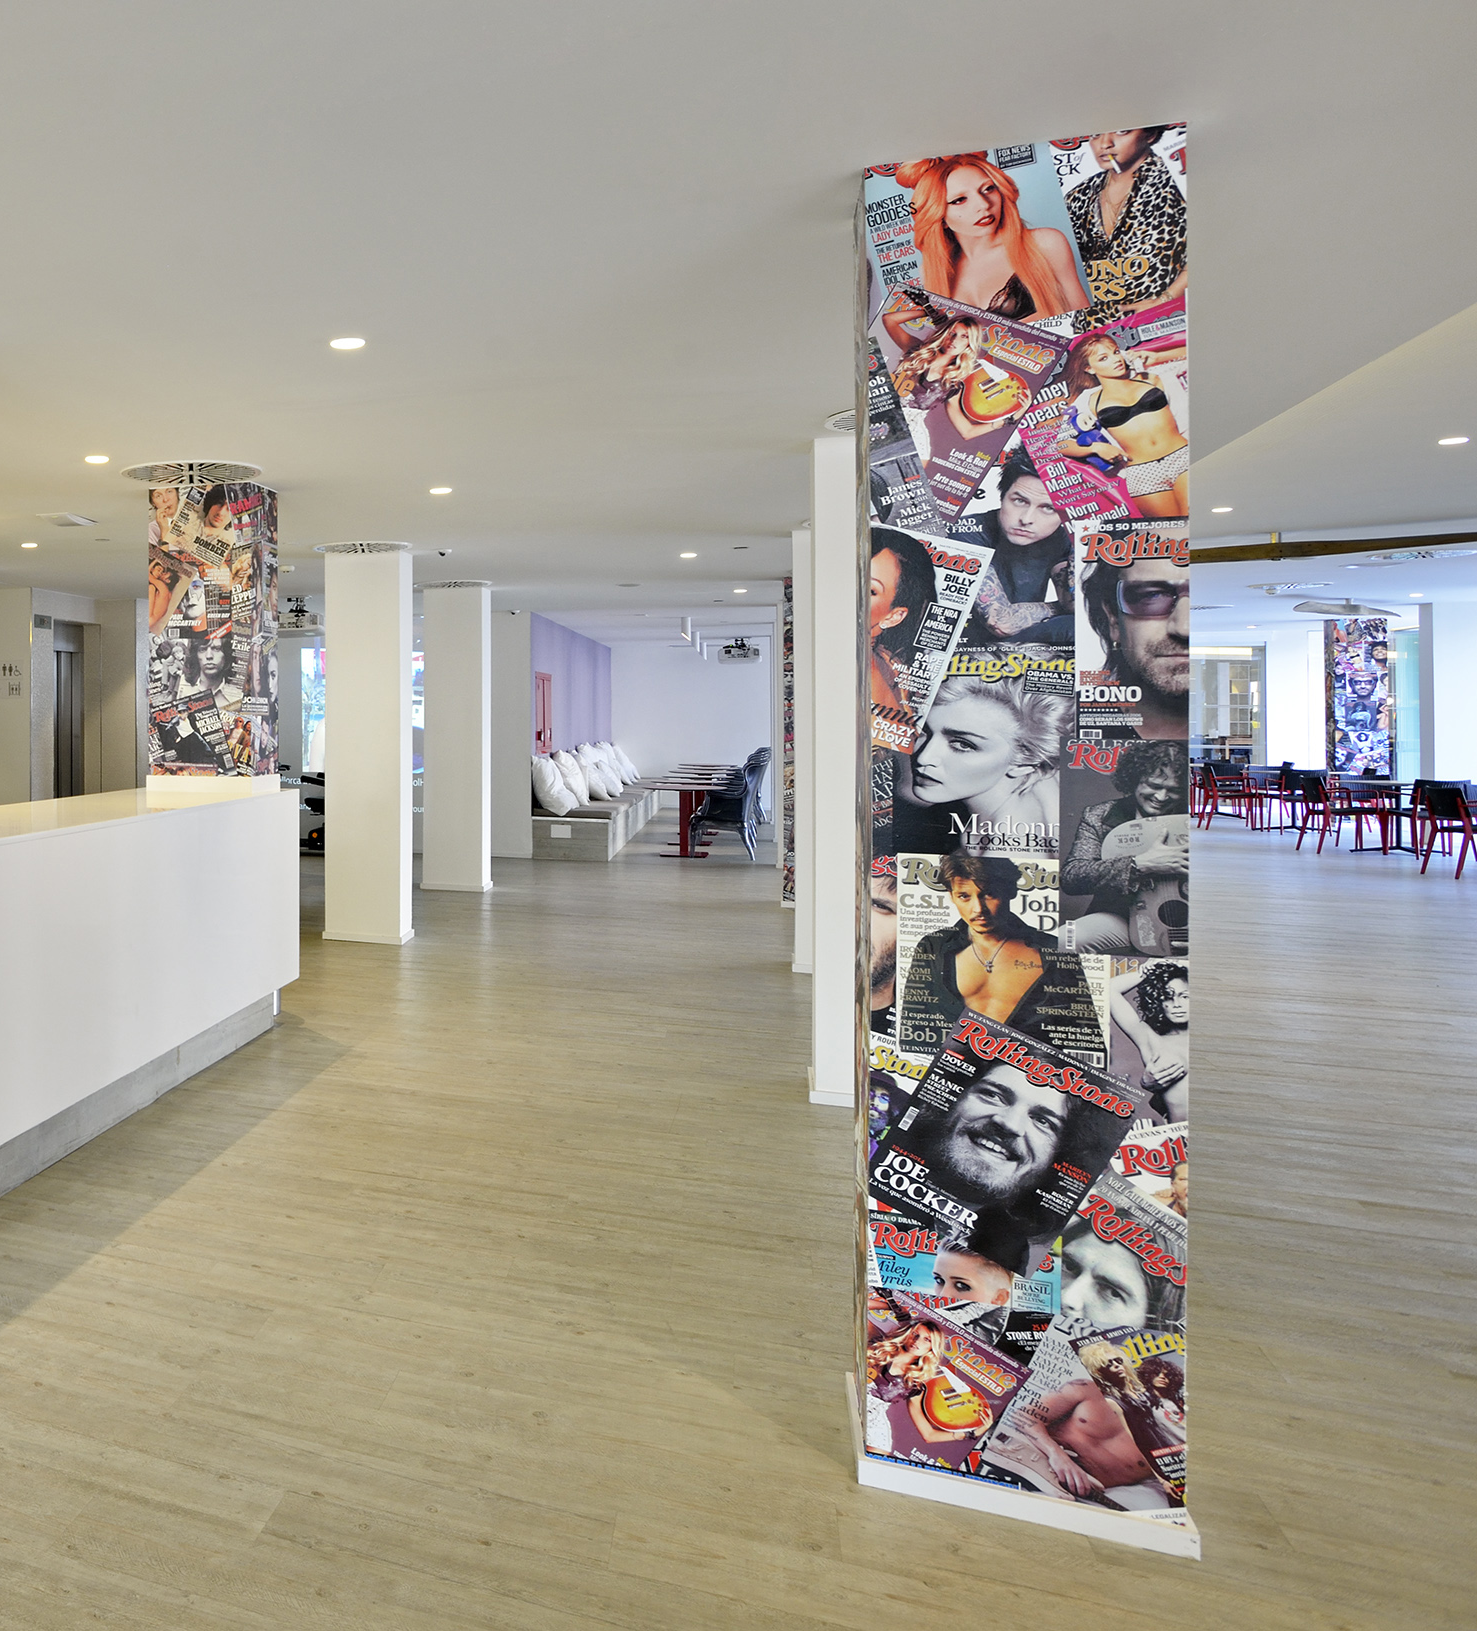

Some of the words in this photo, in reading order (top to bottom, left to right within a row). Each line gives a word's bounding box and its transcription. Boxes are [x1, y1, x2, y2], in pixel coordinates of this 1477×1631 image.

[998, 147, 1011, 156] FOX
[1012, 143, 1031, 153] NEWS
[1009, 151, 1031, 160] FACTORY
[865, 194, 905, 215] MONSTER
[867, 202, 917, 227] GODDESS
[872, 230, 891, 243] LADY
[893, 224, 914, 237] GAGA
[885, 221, 899, 230] WEEK
[885, 241, 905, 252] RETURN
[877, 252, 893, 264] THE
[894, 246, 916, 260] CARS
[882, 261, 918, 277] AMERICAN
[884, 275, 901, 286] IDOL
[983, 312, 1002, 322] ESTILO
[980, 323, 1056, 368] Stone
[992, 345, 1018, 364] Especial
[1017, 355, 1044, 374] ESTILO
[1028, 424, 1053, 436] Inside
[950, 448, 967, 461] Look
[973, 457, 988, 468] Roll
[1045, 461, 1067, 478] Bill
[888, 480, 923, 496] James
[934, 473, 949, 483] Arte
[948, 479, 971, 493] sonoro
[1045, 472, 1083, 493] Maher
[1081, 489, 1096, 498] Say
[1107, 480, 1120, 490] TV
[881, 488, 925, 506] Brown
[1057, 486, 1082, 497] What
[900, 502, 932, 518] Mick
[1065, 502, 1099, 519] Norm
[896, 512, 933, 528] Jagger
[1132, 520, 1184, 530] MEJORES
[952, 525, 983, 533] FROM
[194, 536, 226, 557] BOMBER
[216, 538, 230, 550] THE
[1080, 531, 1189, 567] Rolling
[944, 574, 976, 587] BILLY
[942, 584, 970, 597] JOEL
[931, 606, 944, 614] THE
[944, 608, 958, 619] NRA
[924, 620, 953, 633] AMERICA
[892, 663, 938, 680] MILITARY
[1027, 671, 1059, 679] OBAMA
[1041, 677, 1073, 685] GENERALS
[1079, 686, 1142, 702] BONO
[873, 720, 915, 737] CRAZY
[878, 731, 911, 748] LOVE
[966, 831, 1021, 846] Looks
[900, 894, 950, 909] C.S.I.
[900, 908, 915, 916] Una
[916, 909, 950, 918] profunda
[900, 952, 936, 960] MAIDEN
[1059, 955, 1091, 963] rebelde
[1056, 962, 1104, 971] Hollywood
[1044, 985, 1104, 995] McCARTNEY
[1078, 981, 1104, 989] PAUL
[1036, 1007, 1104, 1018] SPRINGSTEEN
[1071, 1003, 1104, 1011] BRUCE
[900, 1026, 937, 1042] Bob
[1057, 1025, 1081, 1033] series
[1064, 1040, 1104, 1049] escritores
[1077, 1034, 1105, 1042] huelga
[941, 1053, 976, 1074] DOVER
[952, 1018, 1057, 1086] Rolling
[1050, 1067, 1135, 1118] Stone
[1058, 1053, 1088, 1070] MADONNA
[1090, 1068, 1116, 1084] IMAGINE
[1116, 1080, 1145, 1097] DRAGONS
[926, 1079, 950, 1092] STREET
[929, 1074, 964, 1093] MANIC
[924, 1084, 957, 1101] PREACHERS
[1128, 1130, 1161, 1141] CUEVAS
[879, 1149, 929, 1183] JOE
[1106, 1177, 1125, 1194] NOEL
[874, 1167, 978, 1229] COCKER
[878, 1183, 890, 1193] voz
[889, 1189, 902, 1198] que
[901, 1196, 930, 1214] asombró
[935, 1213, 972, 1234] Woodstock
[1076, 1194, 1181, 1276] Rolling
[1014, 1283, 1050, 1295] BRASIL
[1006, 1332, 1033, 1340] STONE
[943, 1336, 1017, 1390] Stone
[954, 1358, 981, 1380] Especial
[981, 1372, 1003, 1394] ESTILO
[1022, 1384, 1042, 1398] Son
[1011, 1399, 1048, 1422] Laden
[1015, 1393, 1027, 1402] of
[1029, 1399, 1050, 1413] Bin
